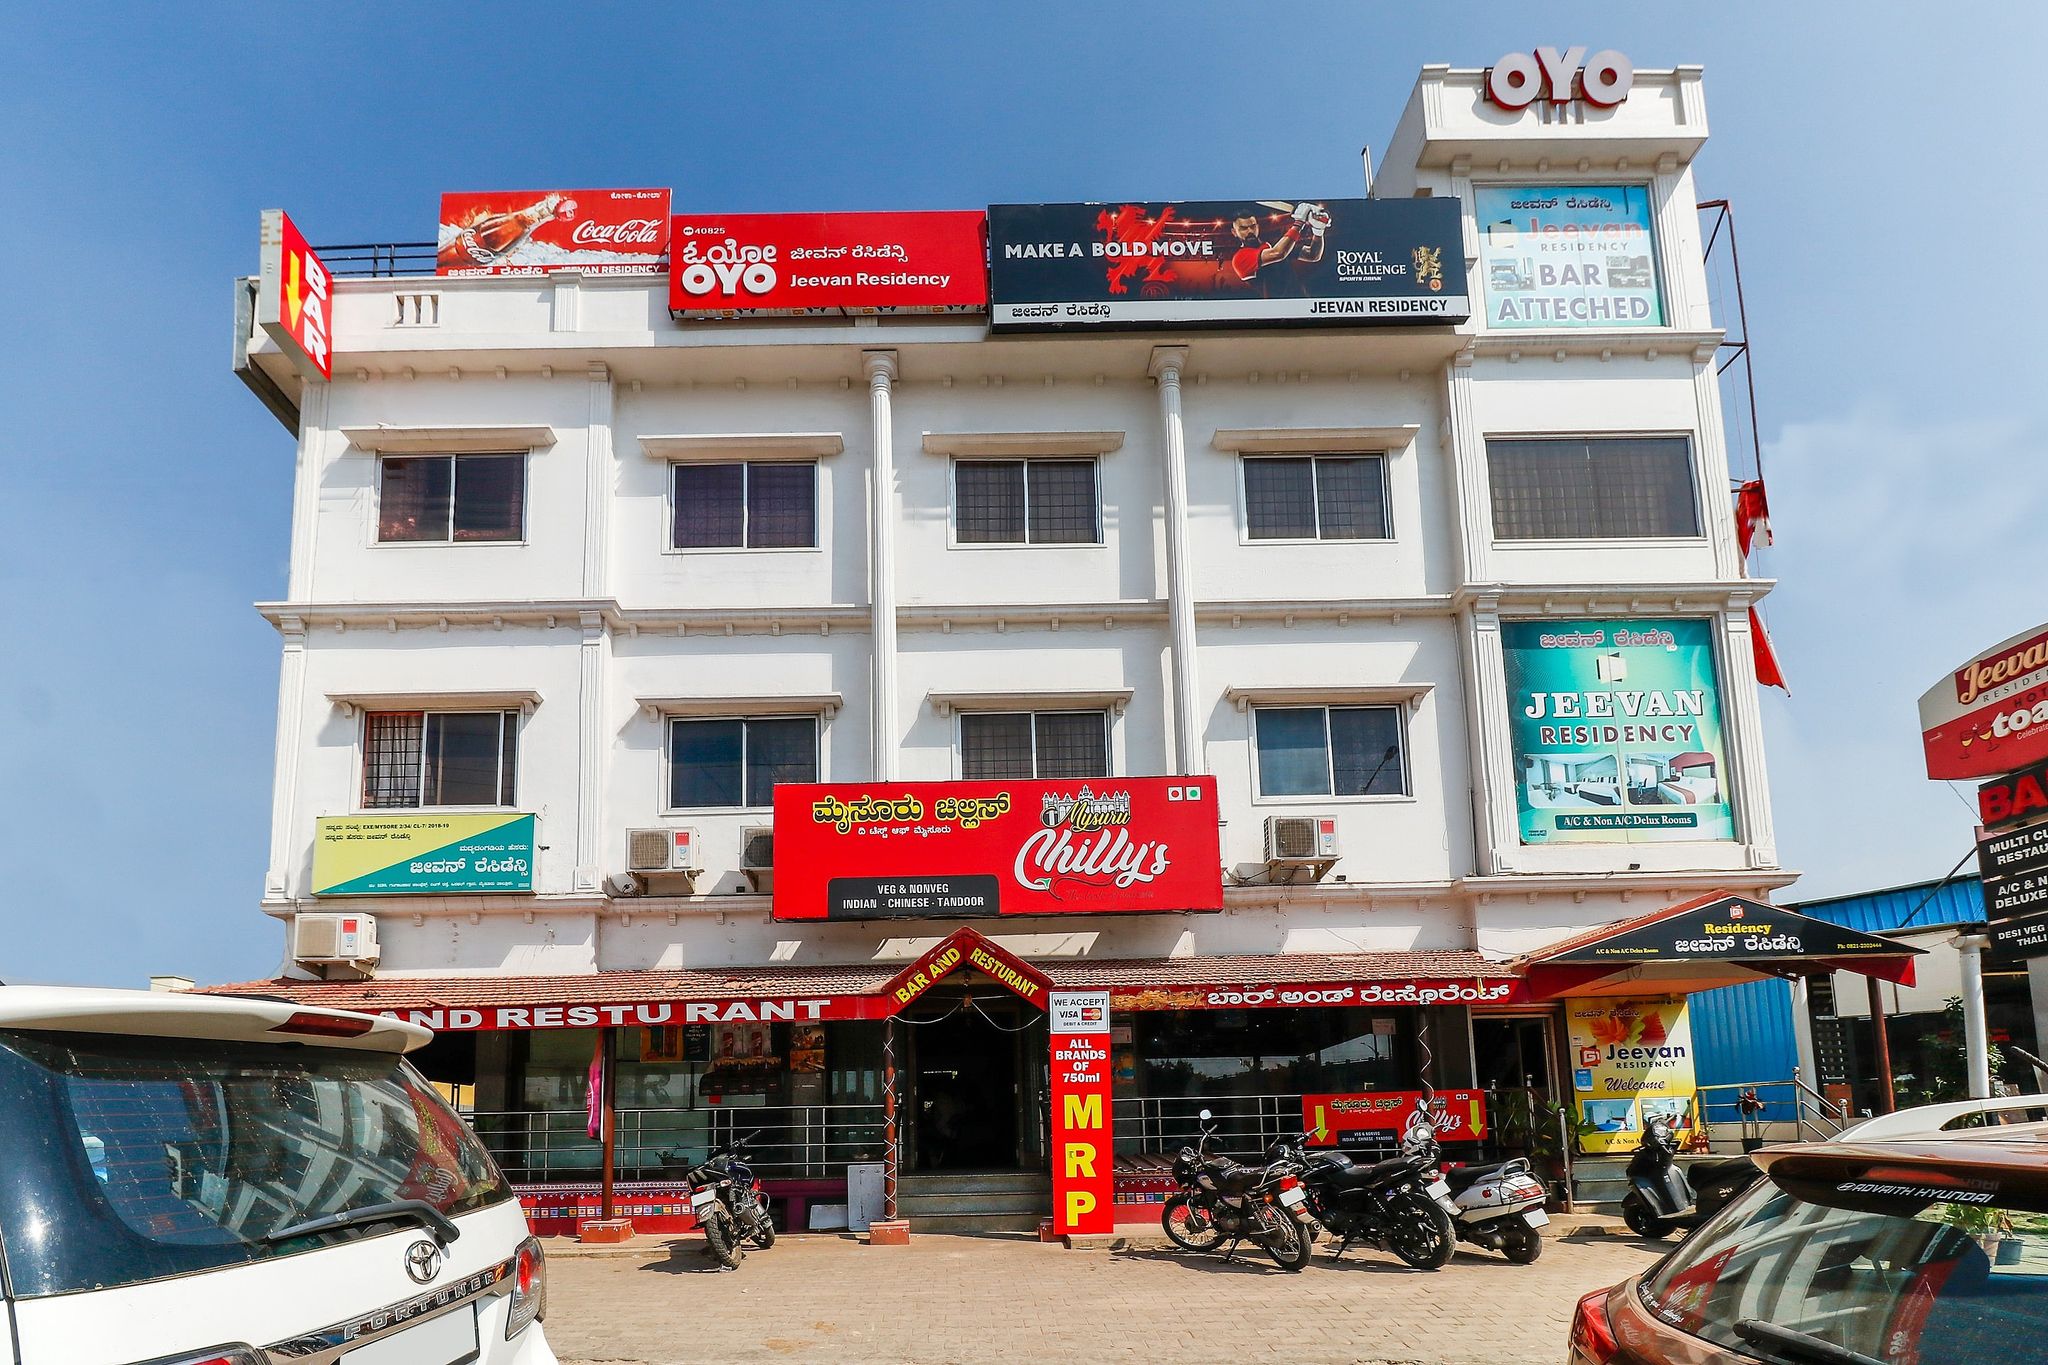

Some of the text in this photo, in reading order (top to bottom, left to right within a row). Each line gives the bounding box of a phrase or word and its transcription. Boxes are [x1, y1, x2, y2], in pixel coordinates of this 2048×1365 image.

[1488, 46, 1634, 109] OYO
[1511, 198, 1558, 210] ಜೀವನ್
[572, 218, 663, 245] Coca-Cola
[694, 227, 726, 235] 40825
[1524, 217, 1644, 240] Jeevan
[790, 244, 909, 263] ಜೀವನ್ ರೆಸಿಡೆನ್ಸಿ
[1005, 240, 1214, 259] MAKE A BOLD MOVE
[1540, 242, 1629, 252] RESIDENCY
[1337, 250, 1383, 264] ROYAL
[602, 264, 660, 274] RESIDENCY
[1337, 264, 1407, 275] CHALLENGE
[1539, 263, 1602, 287] BAR
[682, 263, 777, 295] OYO
[790, 272, 950, 289] Jeevan Residency
[303, 250, 327, 371] BAR
[1012, 304, 1059, 317] ಜೀವನ್
[1310, 299, 1448, 314] JEEVAN RESIDENCY
[1498, 296, 1651, 321] ATTECHED
[1539, 630, 1604, 648] ಜೀವನ್
[1960, 640, 2048, 704] Jeeva
[1983, 668, 2048, 703] RESIDE
[1525, 690, 1704, 719] JEEVAN
[1540, 724, 1693, 745] RESIDENCY
[1979, 768, 2048, 825] BA
[812, 792, 1011, 834] ಮೈಸೂರು ಚಿಲ್ಲಿಸ್
[1041, 801, 1131, 832] Mysuru
[1563, 814, 1692, 827] A/C & Non A/C Delux Rooms
[913, 825, 951, 837] ಮೈಸೂರು
[1989, 828, 2048, 854] MULTI CU
[1013, 828, 1172, 891] Chilly's
[1997, 843, 2048, 865] RESTAU
[410, 857, 529, 876] ಜೀವನ್ ರೆಸಿಡೆನ್ಸಿ
[877, 883, 949, 895] VEG & NONVEG
[1998, 881, 2021, 896] A/C
[2024, 879, 2035, 890] &
[843, 896, 984, 909] INDIAN CHINESE TANDOOR
[1995, 889, 2048, 909] DELUXE
[1703, 922, 1772, 936] Residency
[1998, 924, 2046, 940] DESI VEG
[1675, 935, 1735, 953] ಜೀವನ್
[2017, 933, 2048, 947] THALI
[895, 947, 961, 1004] BAR AND
[969, 947, 1039, 997] RESTURANT
[1053, 998, 1106, 1006] WE ACCEPT
[1208, 989, 1275, 1005] ಬಾರ್
[1281, 987, 1354, 1003] ಅಂಡ್
[1059, 1010, 1079, 1019] VISA
[1069, 1039, 1092, 1049] ALL
[1606, 1044, 1686, 1061] Jeevan
[1055, 1050, 1107, 1060] BRANDS
[1072, 1061, 1090, 1072] OF
[1616, 1060, 1677, 1069] RESIDENCY
[1062, 1072, 1101, 1083] 750ml
[1604, 1076, 1665, 1092] Welcome
[1853, 1183, 1995, 1203] ADVAITH HYUNDAI
[344, 1270, 496, 1341] FORTUNER
